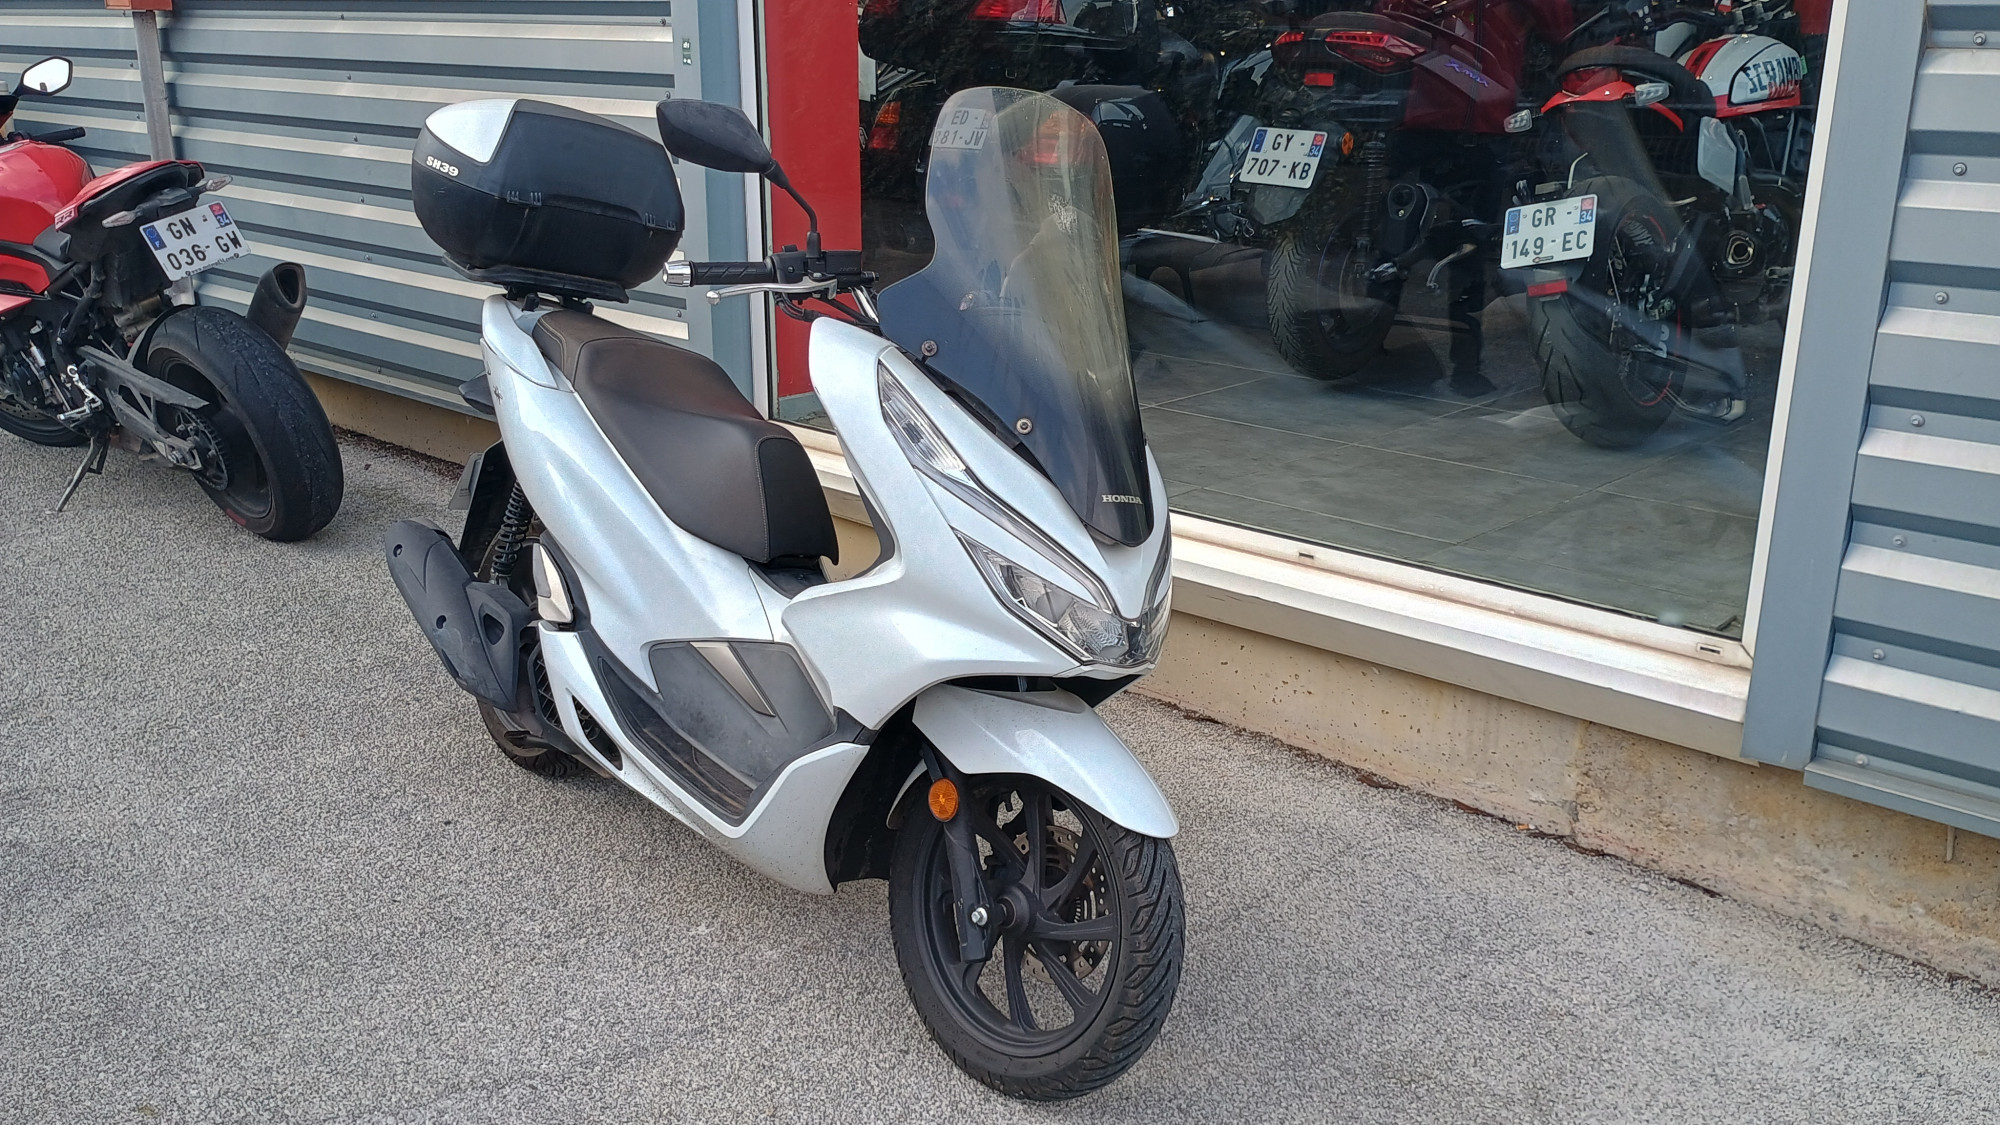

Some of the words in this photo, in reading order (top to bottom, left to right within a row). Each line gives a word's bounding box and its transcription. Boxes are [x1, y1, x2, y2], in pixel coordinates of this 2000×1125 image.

[951, 110, 970, 126] ED
[1271, 133, 1294, 152] GY
[1308, 145, 1320, 156] 34
[426, 155, 459, 177] SH39
[215, 214, 231, 227] 34
[1531, 206, 1557, 228] GR
[1580, 210, 1593, 222] 34
[166, 216, 197, 240] GN
[1101, 494, 1143, 505] HONDA
